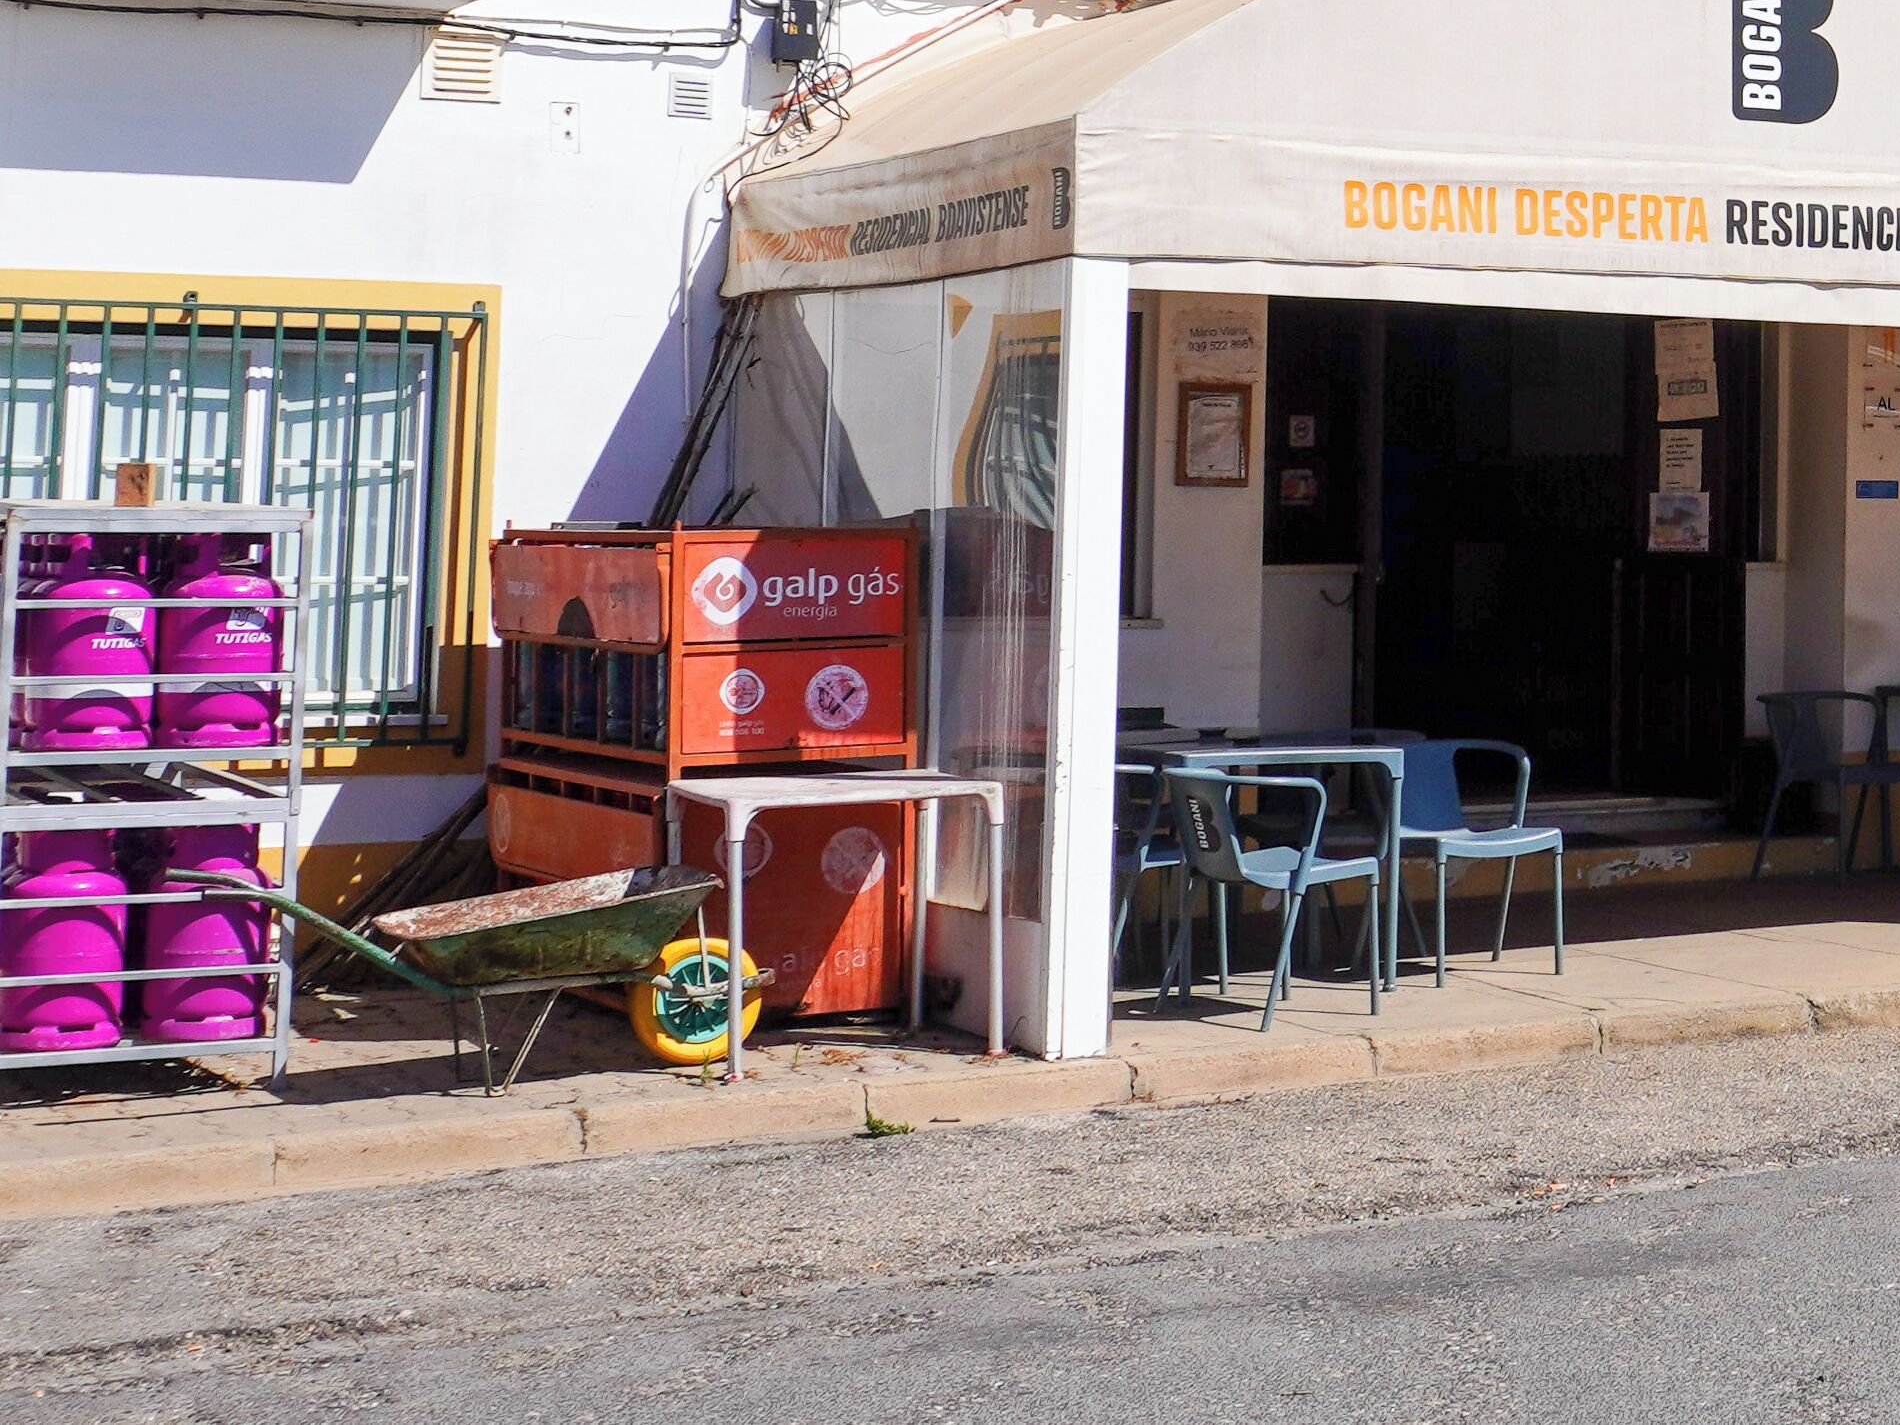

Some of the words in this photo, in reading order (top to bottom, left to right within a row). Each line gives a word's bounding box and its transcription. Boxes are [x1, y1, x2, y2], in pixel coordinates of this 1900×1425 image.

[850, 206, 931, 255] RESIDENCIAL
[935, 185, 1030, 243] BOAVISTENSE
[1344, 179, 1498, 236] BOGANI
[1515, 188, 1709, 244] DESPERTA
[1877, 397, 1896, 411] AL
[762, 567, 839, 607] galp
[847, 566, 901, 605] gás
[782, 602, 838, 621] energia
[91, 637, 147, 649] TUTIGAS
[215, 632, 273, 645] TUTIGAS
[1189, 799, 1209, 849] BOGANI
